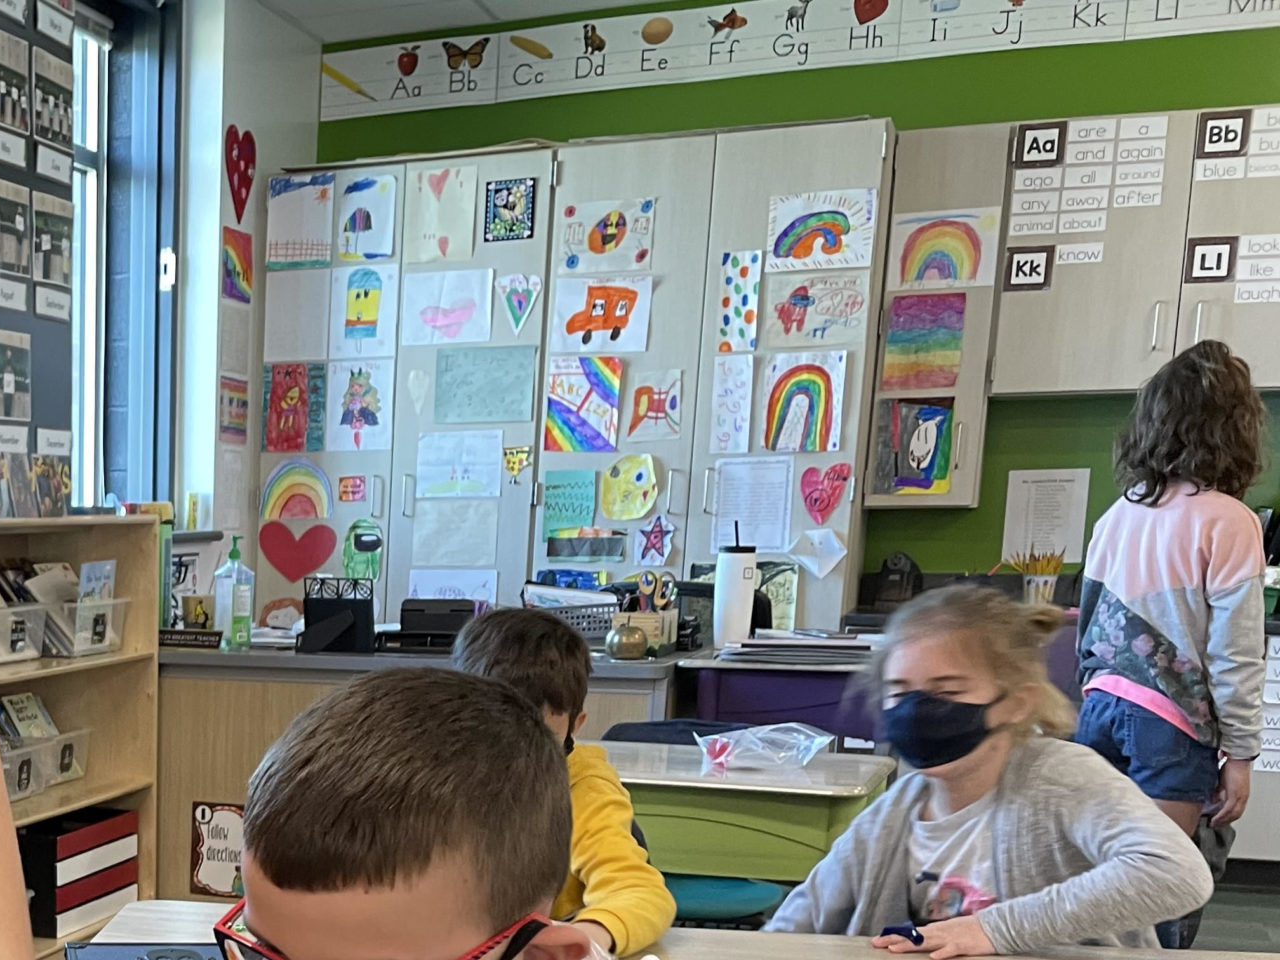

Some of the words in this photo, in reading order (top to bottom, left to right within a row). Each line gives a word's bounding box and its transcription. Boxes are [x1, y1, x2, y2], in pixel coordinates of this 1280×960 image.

[390, 78, 422, 99] Aa
[449, 70, 478, 93] Bb
[513, 64, 544, 86] Cc
[575, 54, 605, 79] Dd
[641, 49, 669, 72] Ee
[709, 40, 740, 65] Ff
[772, 33, 810, 65] Gg
[849, 26, 883, 50] Hh
[930, 18, 948, 42] Ii
[992, 10, 1024, 45] Jj
[1072, 2, 1108, 29] Kk
[1078, 125, 1107, 139] are
[1138, 124, 1150, 136] a
[1208, 125, 1239, 144] Bb
[1027, 137, 1056, 154] Aa
[1075, 147, 1106, 162] and
[1119, 145, 1163, 162] again
[1080, 170, 1097, 185] all
[1119, 167, 1161, 182] around
[1203, 163, 1238, 179] blue
[1023, 175, 1053, 190] ago
[1021, 198, 1051, 212] any
[1065, 195, 1104, 210] away
[1114, 190, 1161, 206] after
[1013, 219, 1055, 234] animal
[1062, 216, 1103, 230] about
[1057, 246, 1102, 264] know
[1200, 252, 1223, 271] Ll
[1015, 259, 1042, 278] Kk
[1250, 263, 1274, 277] like
